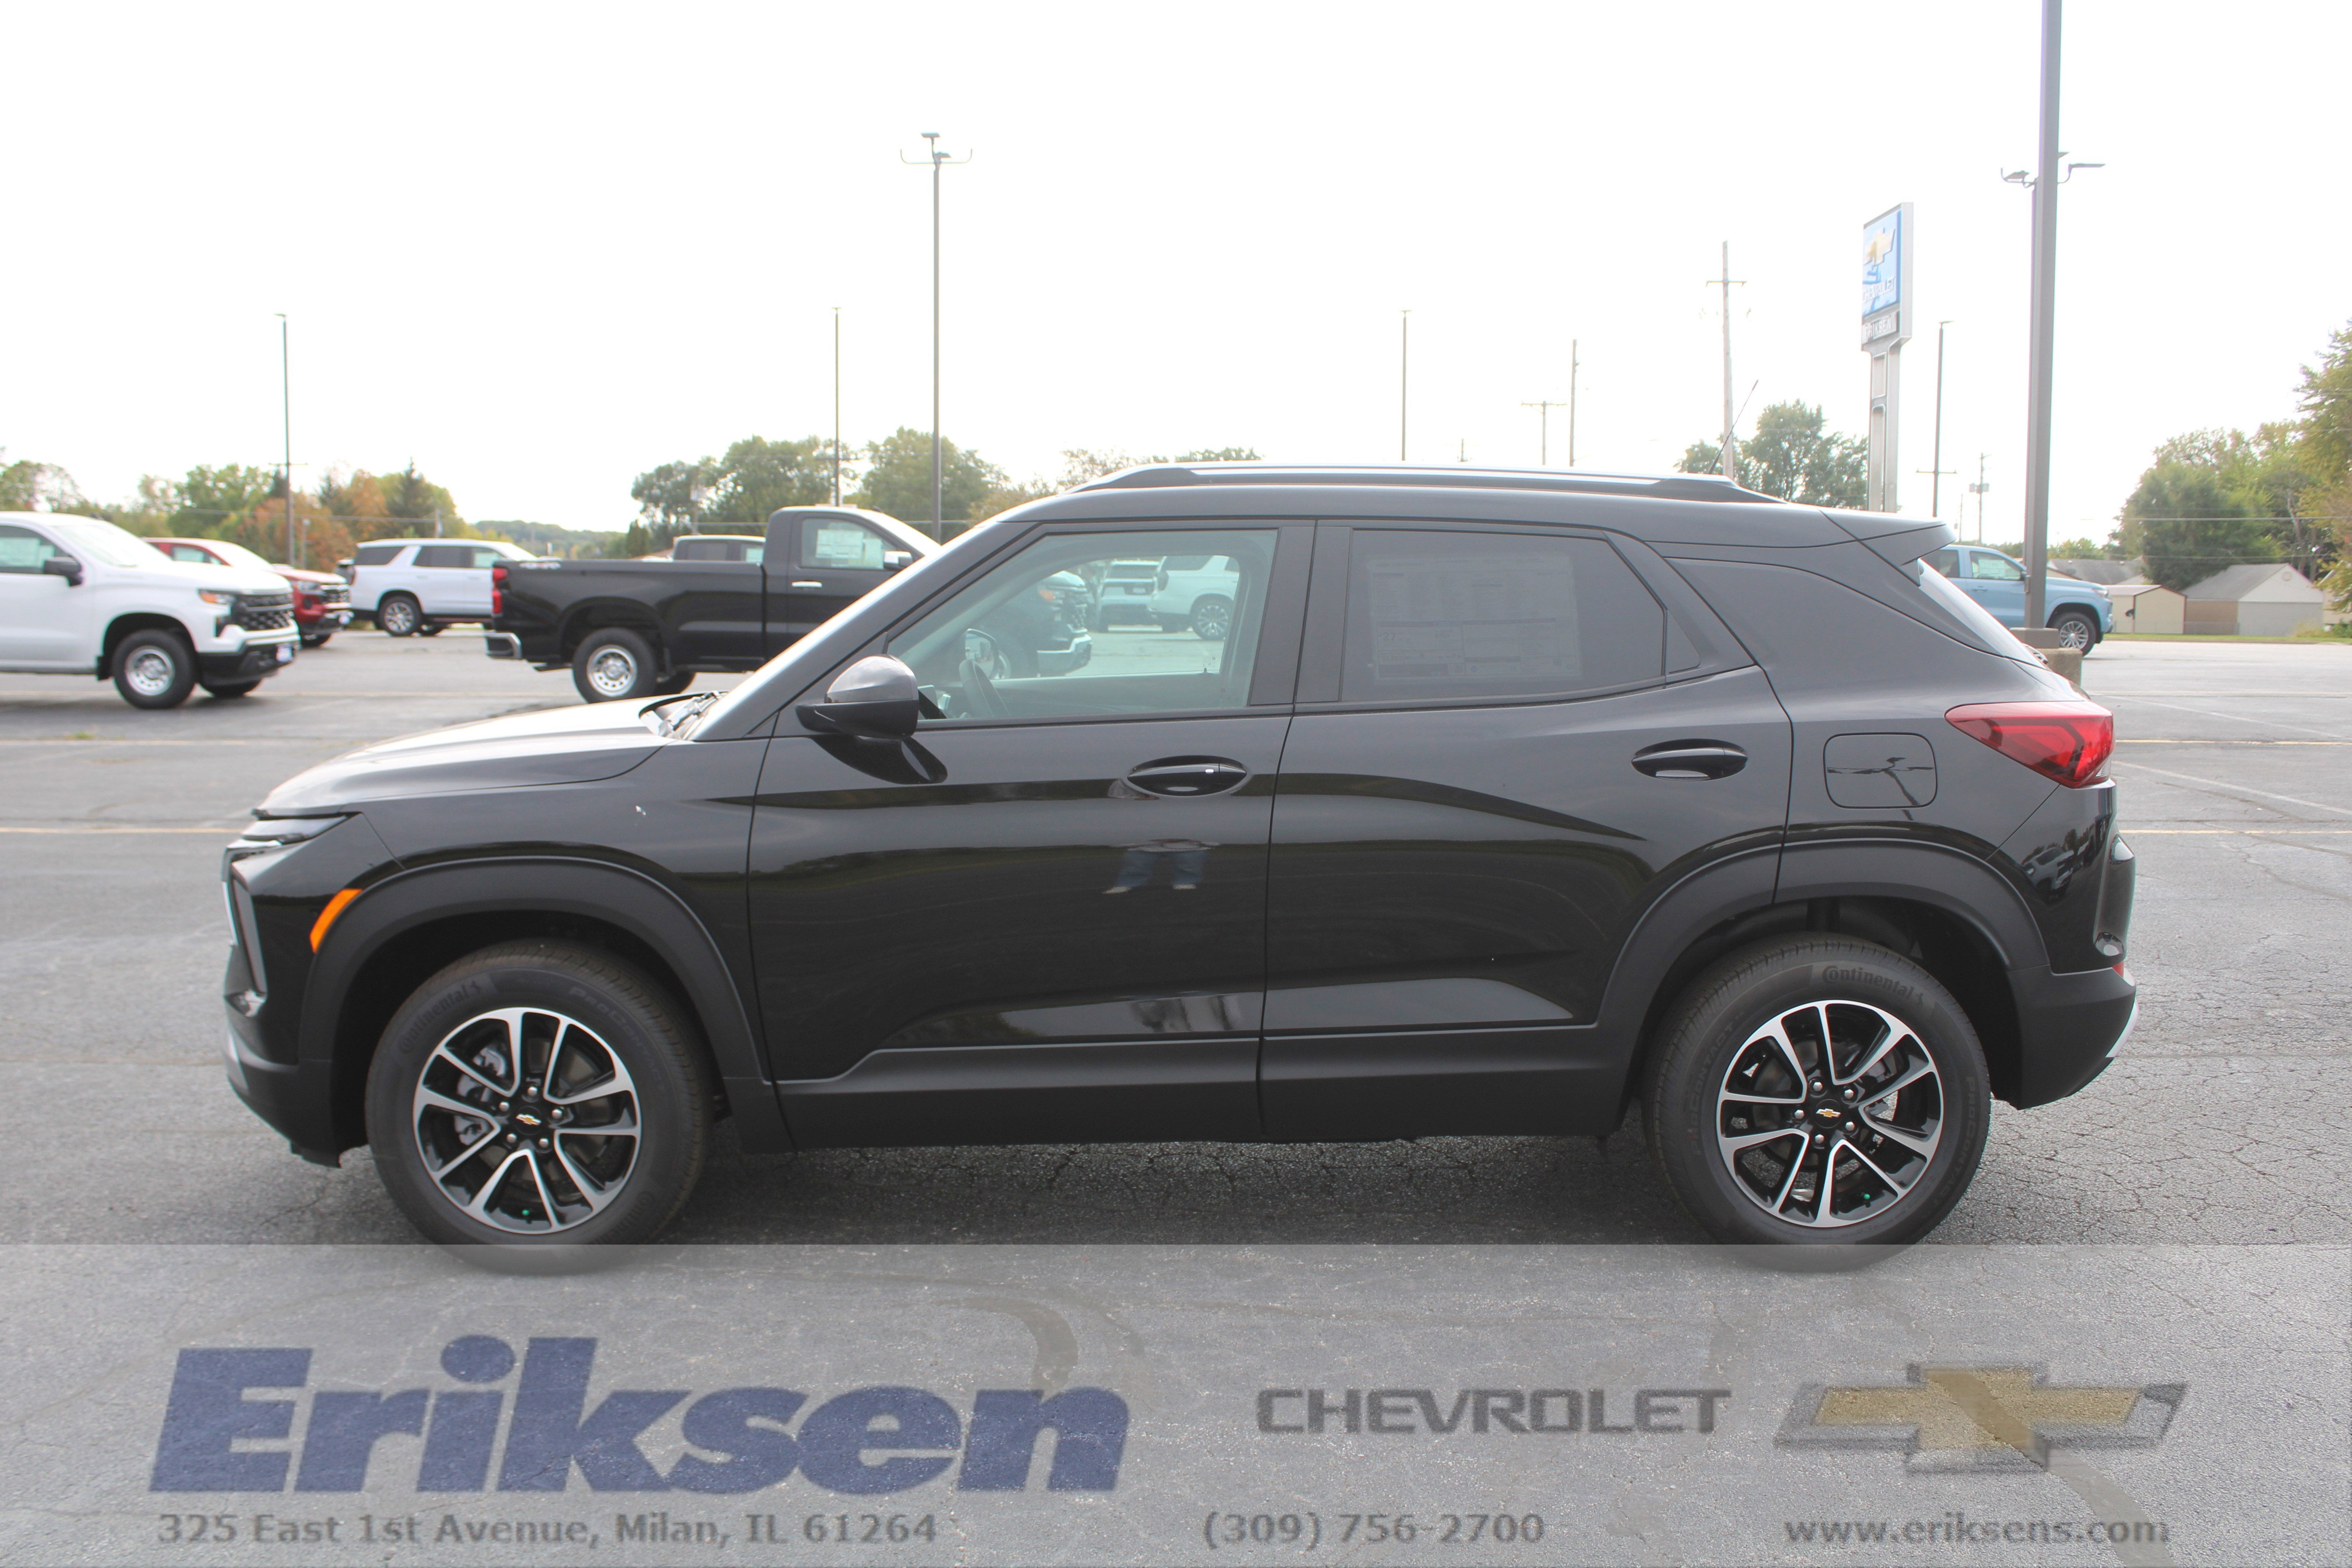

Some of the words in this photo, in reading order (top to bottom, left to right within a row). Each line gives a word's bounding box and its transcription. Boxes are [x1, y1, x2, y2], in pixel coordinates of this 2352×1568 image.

[1862, 276, 1896, 304] CHEVROLET
[1865, 318, 1891, 339] ERIKSEN
[1822, 965, 1915, 1000] Continental
